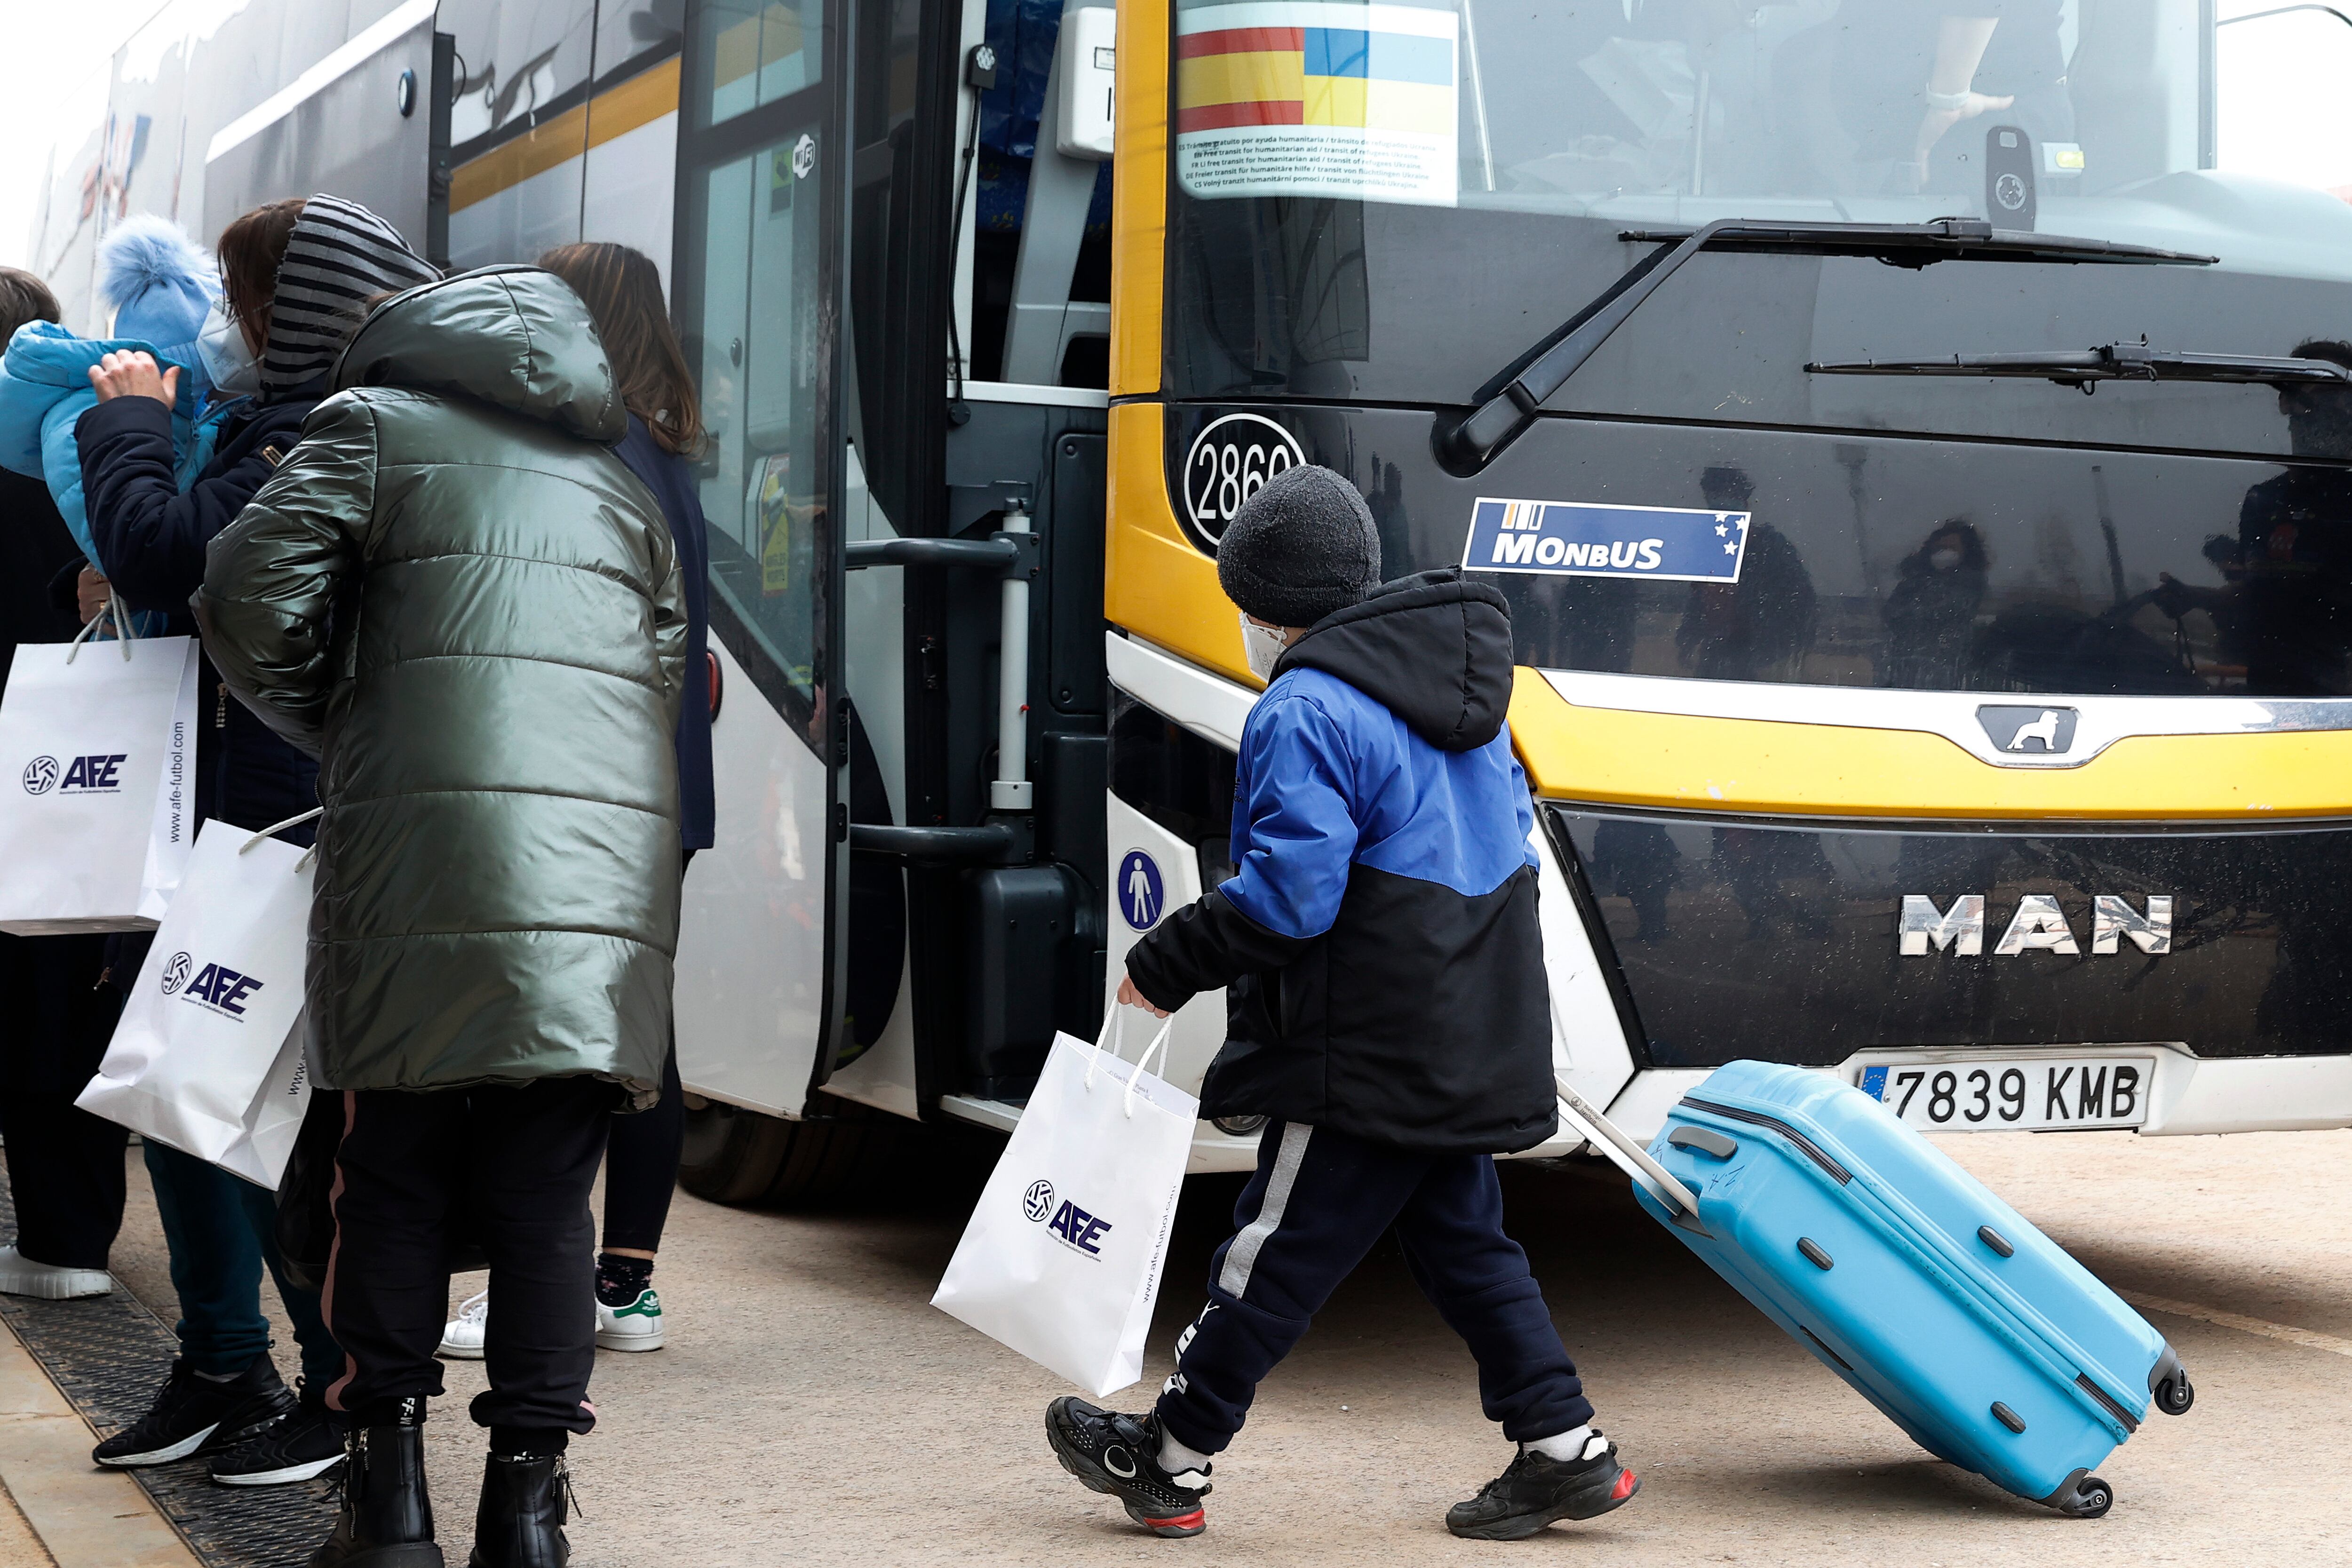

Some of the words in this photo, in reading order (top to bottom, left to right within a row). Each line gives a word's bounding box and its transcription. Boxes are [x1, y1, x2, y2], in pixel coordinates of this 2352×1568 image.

[1359, 149, 1389, 157] refugees
[60, 754, 128, 788] AFE
[169, 721, 184, 843] www.afe-futbol.com
[1899, 895, 2172, 956] MAN
[184, 963, 264, 1015] AFE
[1896, 1067, 2026, 1123] 7839
[2046, 1066, 2139, 1120] KMB
[1049, 1199, 1112, 1254] AFE
